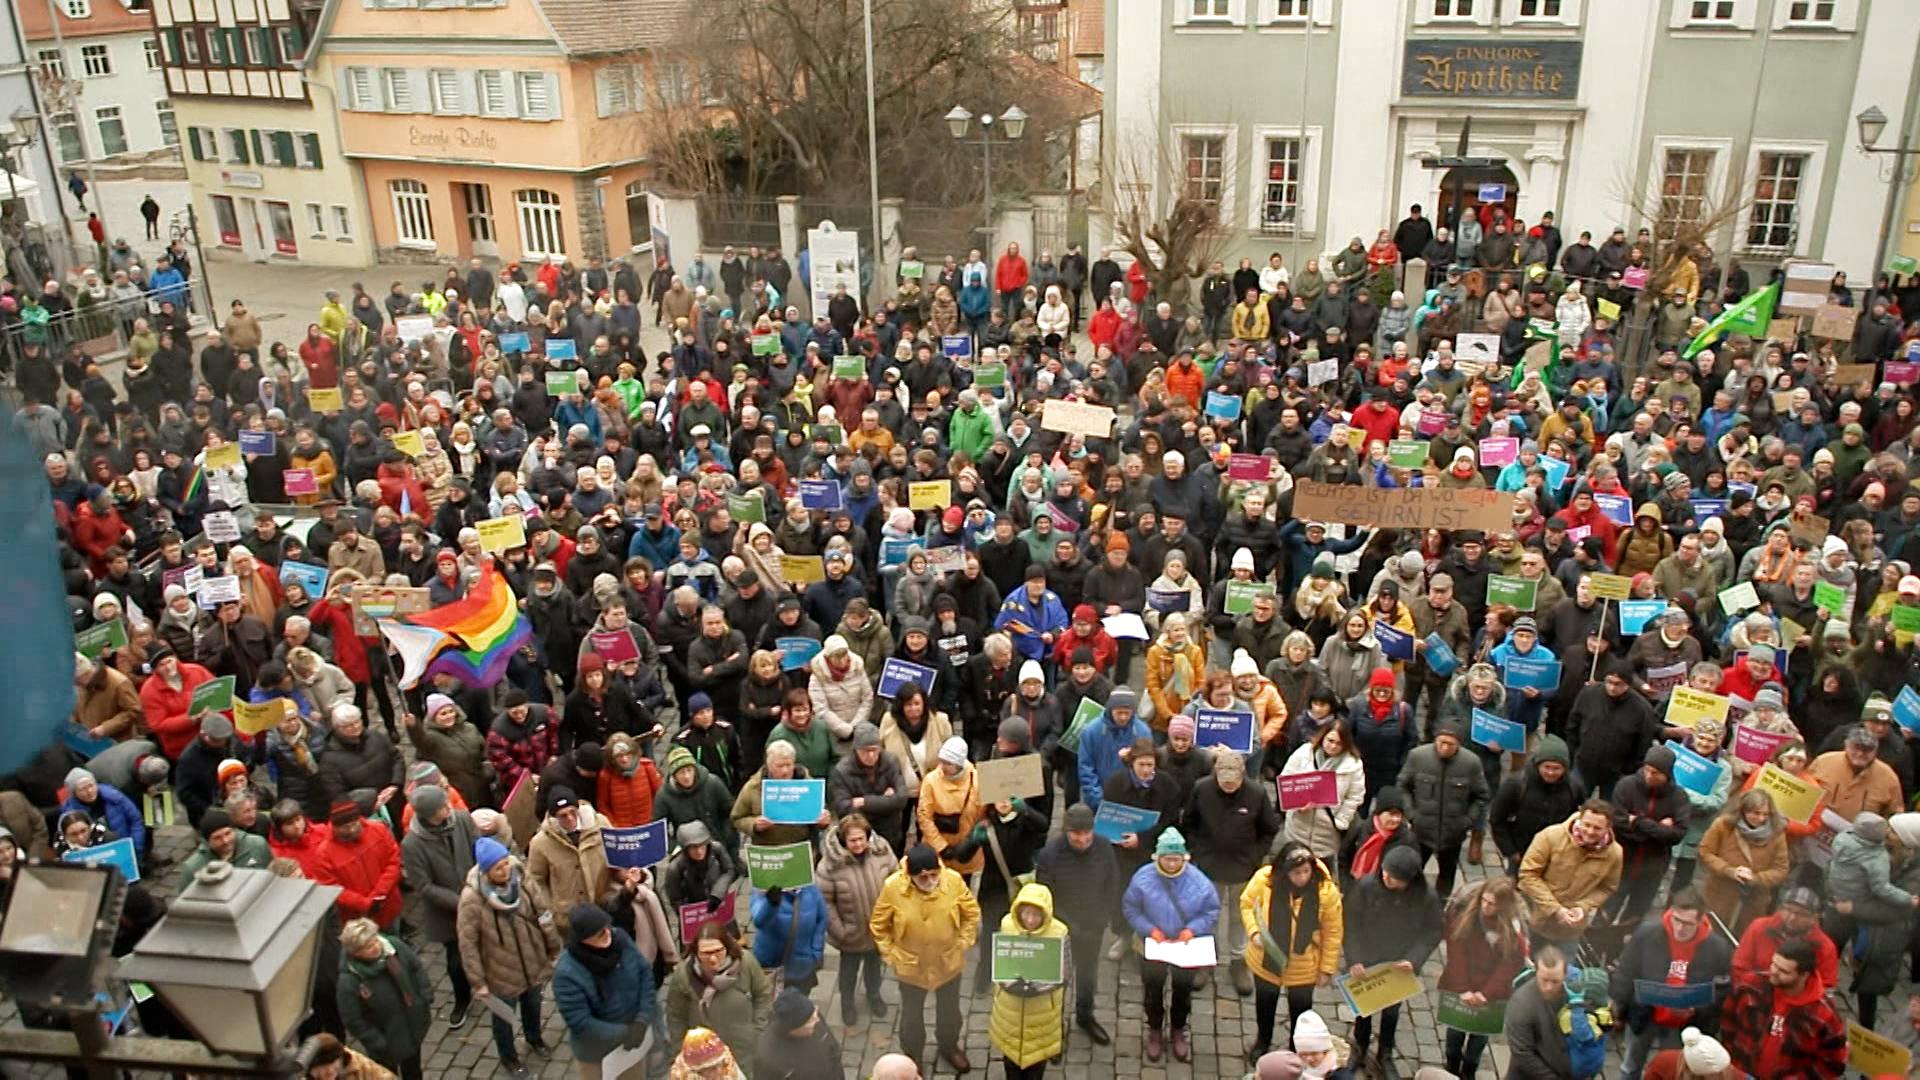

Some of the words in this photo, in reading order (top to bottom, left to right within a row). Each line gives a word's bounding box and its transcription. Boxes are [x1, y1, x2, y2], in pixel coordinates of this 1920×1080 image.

[1456, 47, 1541, 61] EINHORN-
[1416, 54, 1563, 94] Apotheke
[1366, 488, 1390, 504] IST
[1403, 488, 1422, 504] DA
[1428, 488, 1454, 502] WO
[1335, 502, 1423, 526] GEHIRN
[1432, 507, 1470, 528] IST
